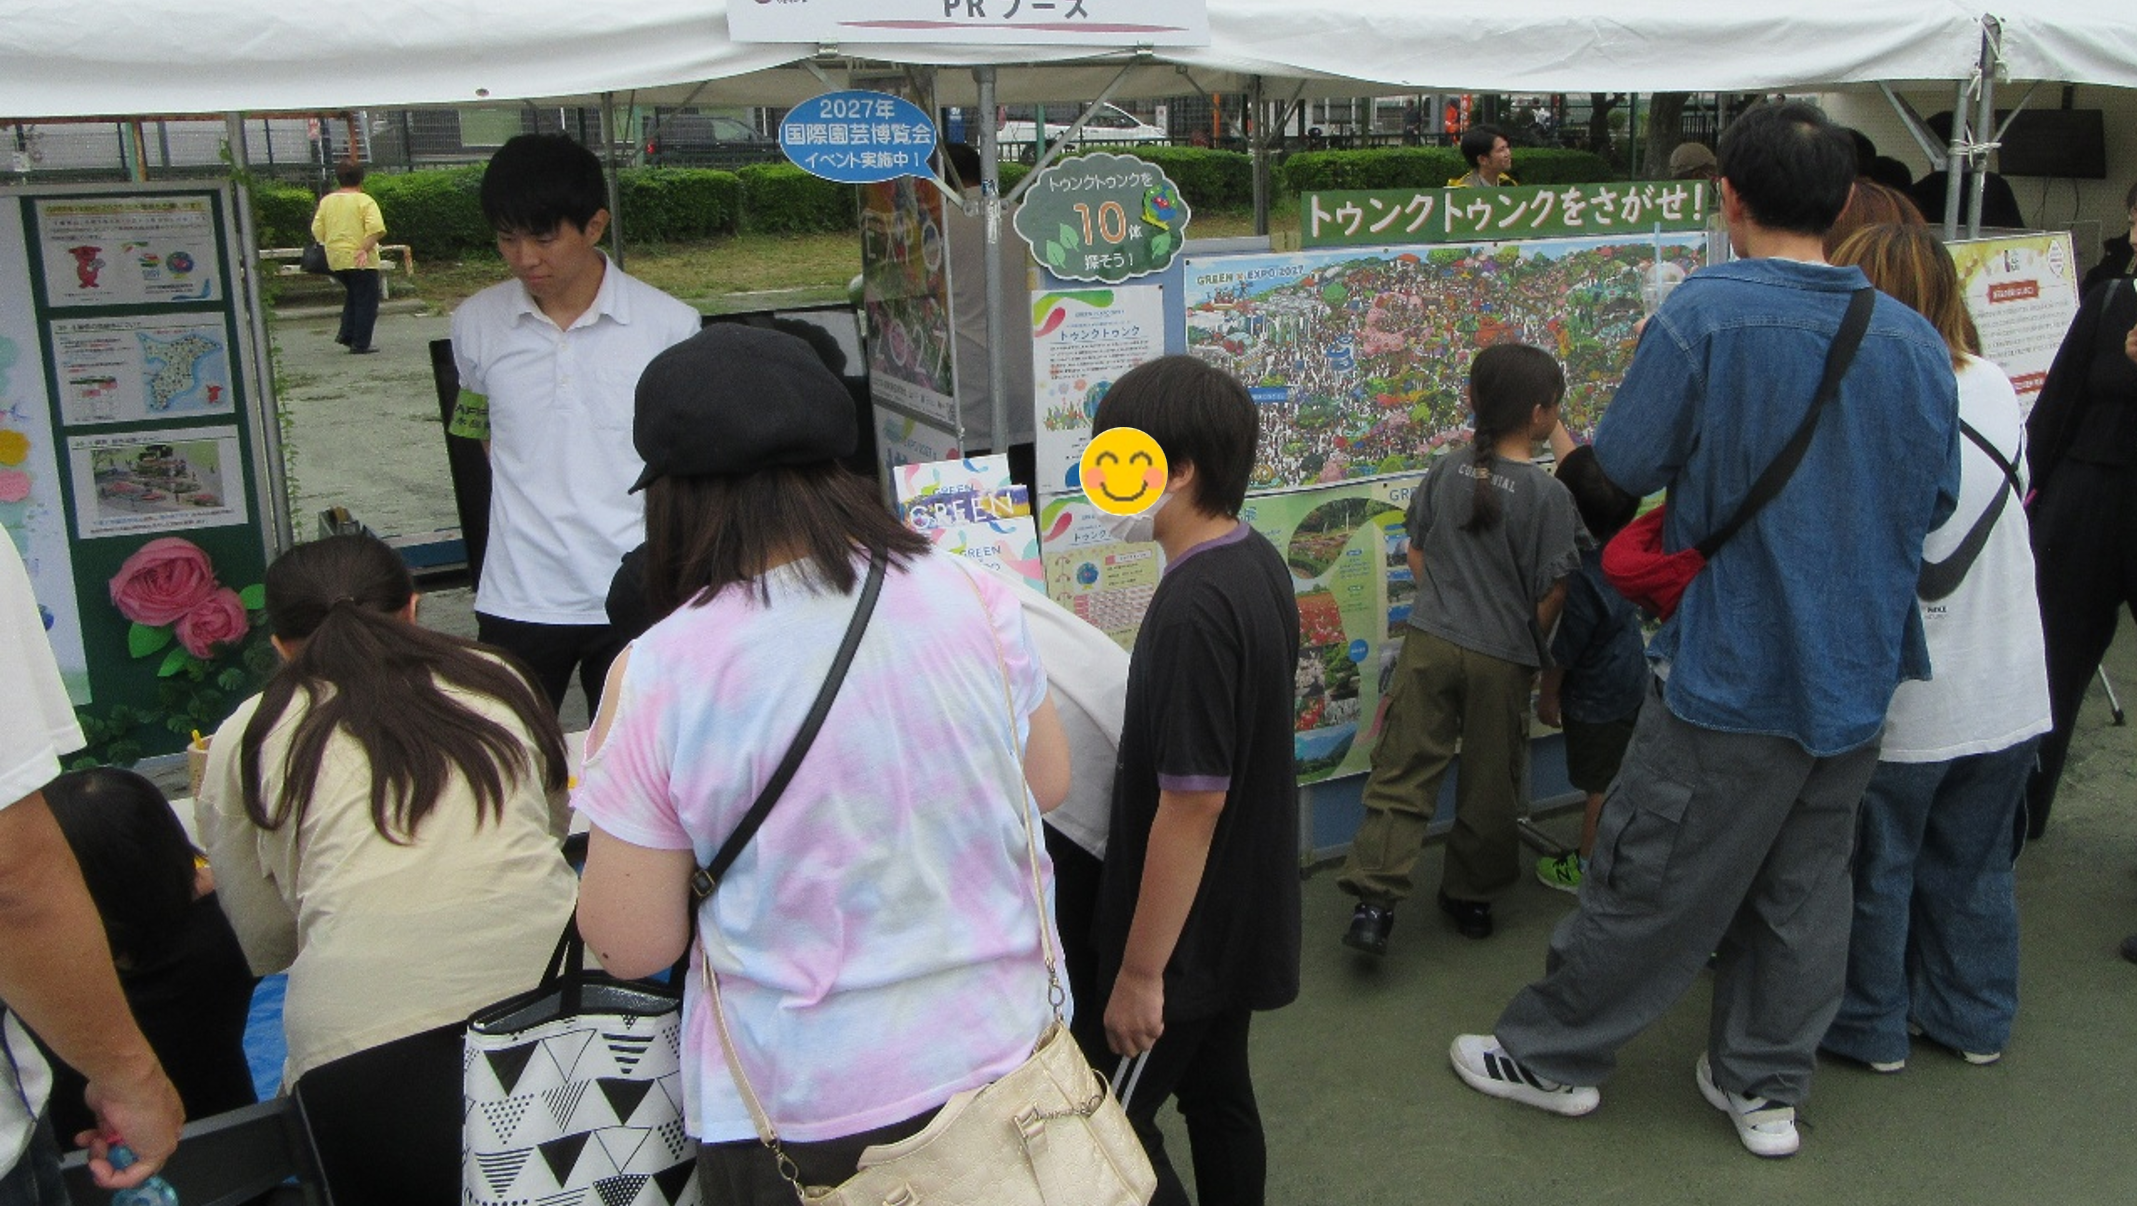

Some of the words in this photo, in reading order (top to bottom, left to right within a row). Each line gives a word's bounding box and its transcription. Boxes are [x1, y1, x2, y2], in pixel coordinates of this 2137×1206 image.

[943, 0, 986, 18] PR
[819, 99, 895, 119] 2027年
[784, 123, 931, 145] 国際園芸博覧会
[804, 151, 920, 169] イベント実施中!
[1049, 172, 1153, 192] トゥンクトゥンクを
[1197, 272, 1233, 285] GREEN
[1247, 267, 1275, 280] EXPO
[1279, 264, 1304, 276] 2027
